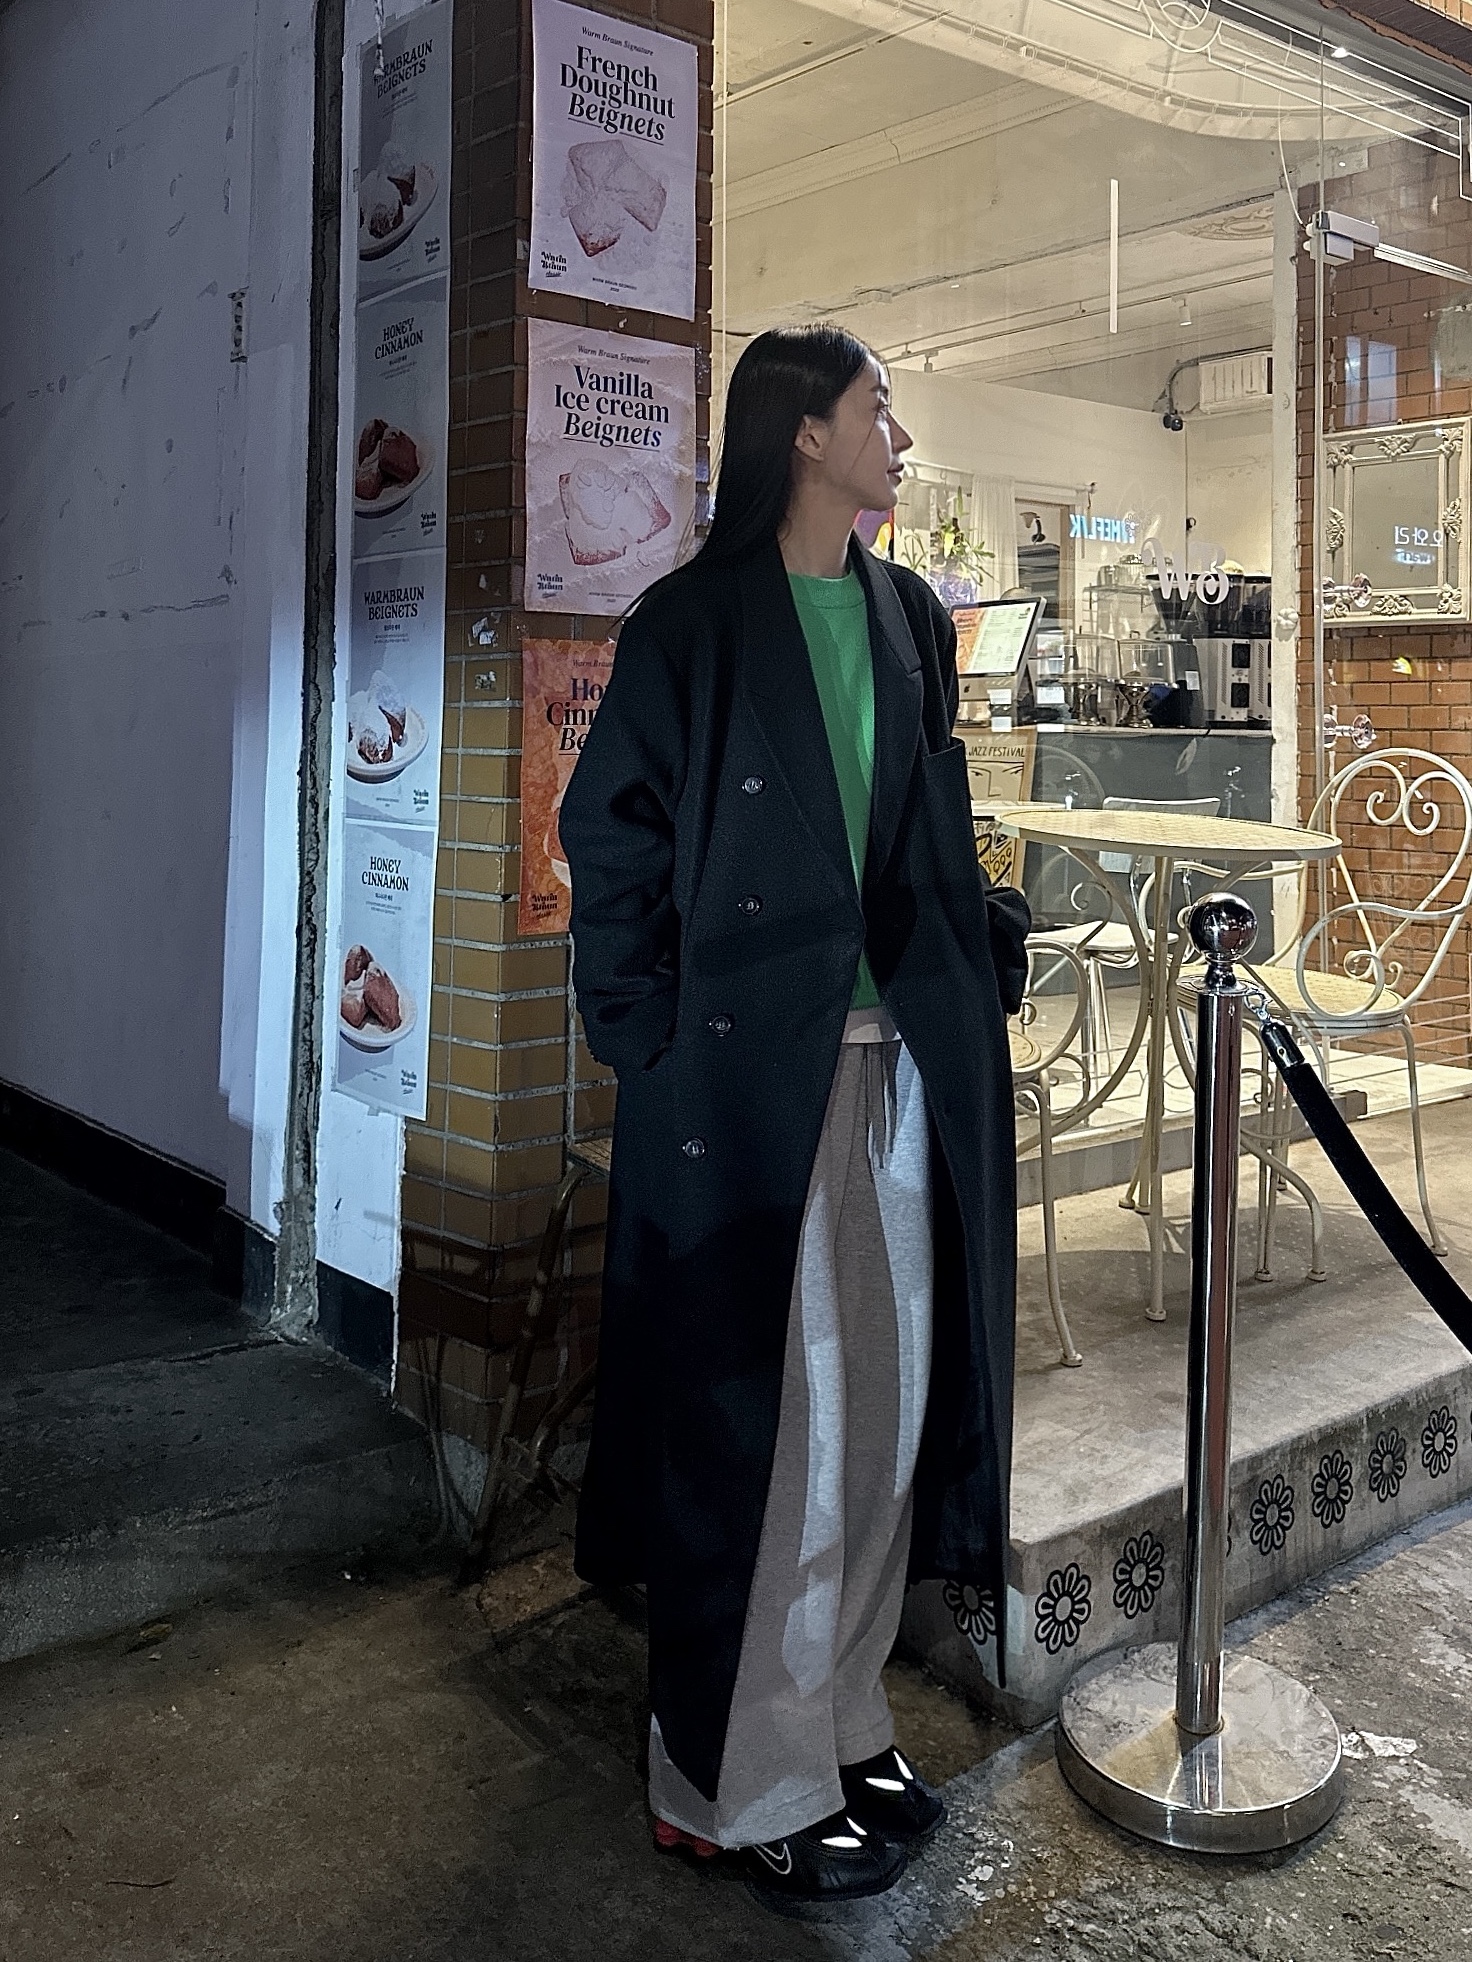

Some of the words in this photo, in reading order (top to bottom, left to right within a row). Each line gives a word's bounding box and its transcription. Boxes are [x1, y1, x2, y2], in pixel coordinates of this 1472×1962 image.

[582, 26, 600, 40] Warm
[602, 33, 622, 46] Braun
[623, 40, 654, 56] Signature
[377, 58, 426, 99] BEIGNETS
[576, 45, 658, 92] French
[560, 62, 676, 119] Doughnut
[568, 92, 665, 141] Beignets
[374, 329, 423, 360] CINNAMON
[383, 317, 415, 342] HONEY
[573, 364, 654, 400] Vanilla
[554, 384, 590, 412] Ice
[595, 396, 669, 424] cream
[563, 412, 662, 448] Beignets
[364, 586, 425, 606] WARMBRAUN
[368, 602, 418, 621] BEIGNETS
[571, 678, 607, 701] Ho
[968, 746, 988, 757] JAZZ
[988, 746, 1026, 758] FESTIVAL
[370, 856, 402, 874] HONEY
[361, 871, 410, 892] CINNAMON
